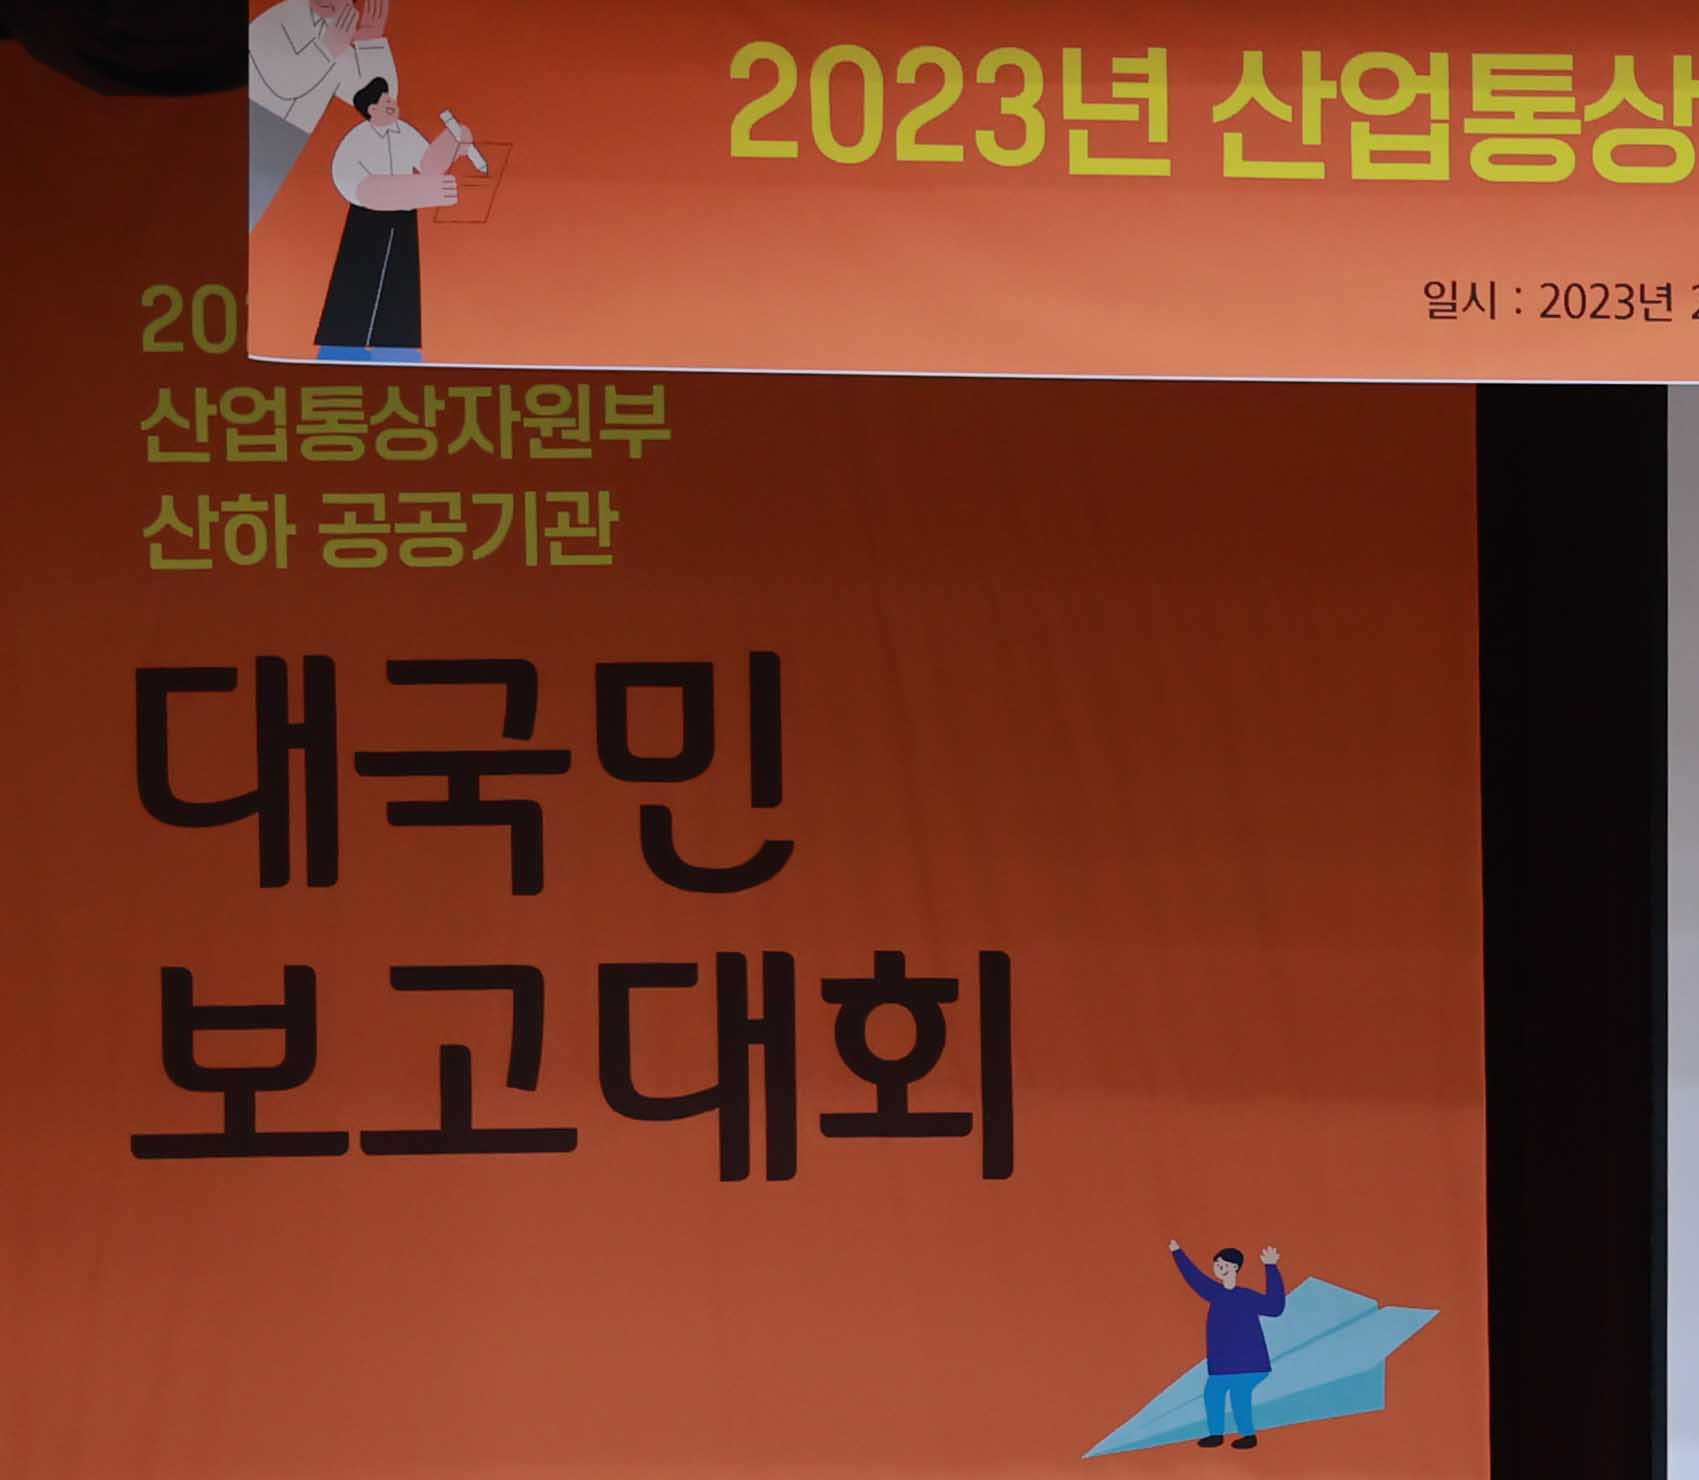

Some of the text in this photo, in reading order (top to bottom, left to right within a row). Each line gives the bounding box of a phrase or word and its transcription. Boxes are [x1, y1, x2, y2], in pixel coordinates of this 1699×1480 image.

[729, 41, 1171, 177] 2023년
[1423, 281, 1498, 321] 일시
[1538, 281, 1672, 323] 2023년
[140, 384, 671, 463] 산업통상자원부
[143, 490, 619, 570] 산하 공공기관
[134, 650, 795, 896] 대국민
[130, 950, 1014, 1182] 보고대회
